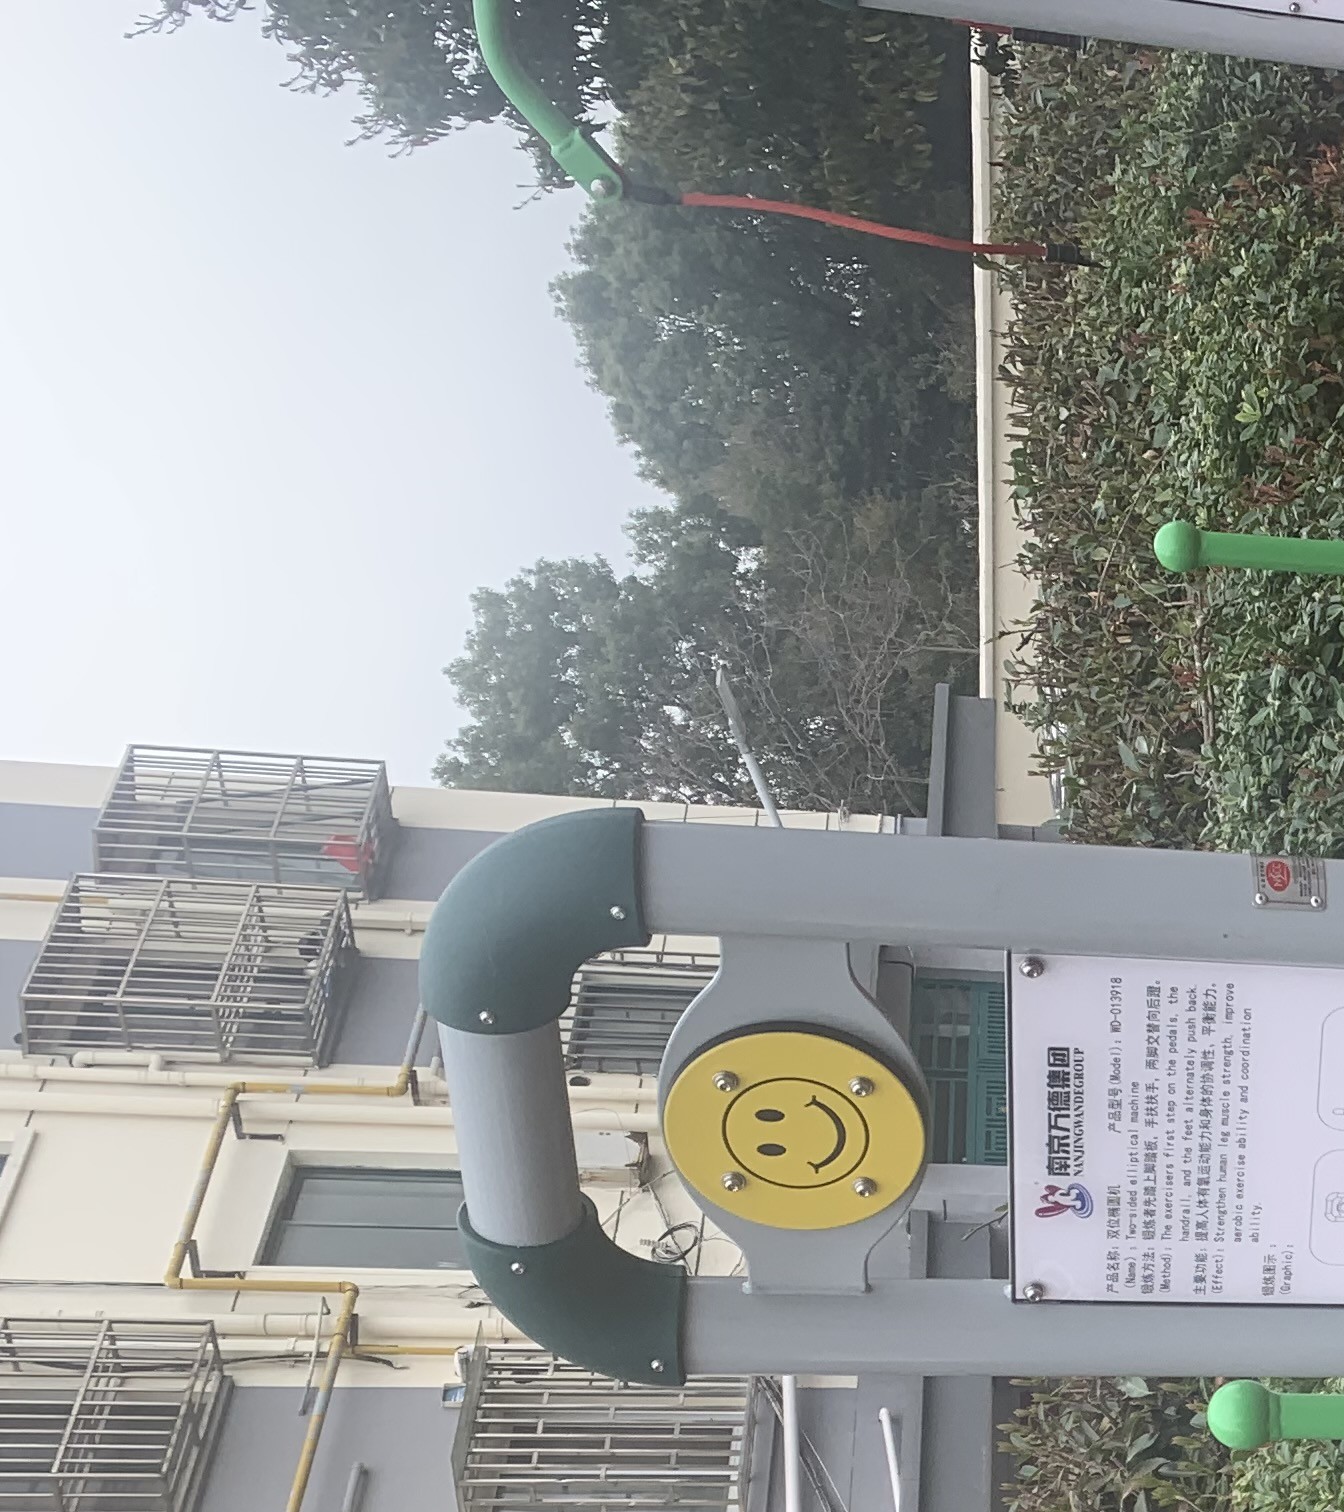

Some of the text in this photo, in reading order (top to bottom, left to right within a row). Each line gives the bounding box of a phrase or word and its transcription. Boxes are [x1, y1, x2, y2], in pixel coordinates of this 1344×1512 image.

[1109, 976, 1123, 1034] WD-013918
[1166, 986, 1179, 1005] the
[1221, 982, 1236, 1025] improve
[1184, 1017, 1199, 1043] push
[1164, 1058, 1178, 1078] the
[1181, 1047, 1199, 1114] alternately
[1127, 1081, 1140, 1124] machine
[1167, 1082, 1177, 1096] on
[1044, 1045, 1072, 1178] 南京万德集团
[1070, 1047, 1086, 1178] NANJINGWANDEGROUP
[1164, 1099, 1179, 1124] step
[1218, 1090, 1231, 1127] muscle
[1231, 1007, 1253, 1243] aerobic exercise ability and coordination
[1162, 1129, 1176, 1159] first
[1180, 1118, 1194, 1142] feet
[1216, 1130, 1232, 1148] leg
[1126, 1128, 1140, 1186] elliptical
[1180, 1146, 1193, 1165] the
[1215, 1153, 1229, 1183] human
[1159, 1163, 1175, 1220] exercisers
[1179, 1169, 1193, 1187] and
[1124, 1189, 1138, 1241] Two-sided
[1212, 1186, 1229, 1243] Strengthen
[1160, 1224, 1173, 1241] The
